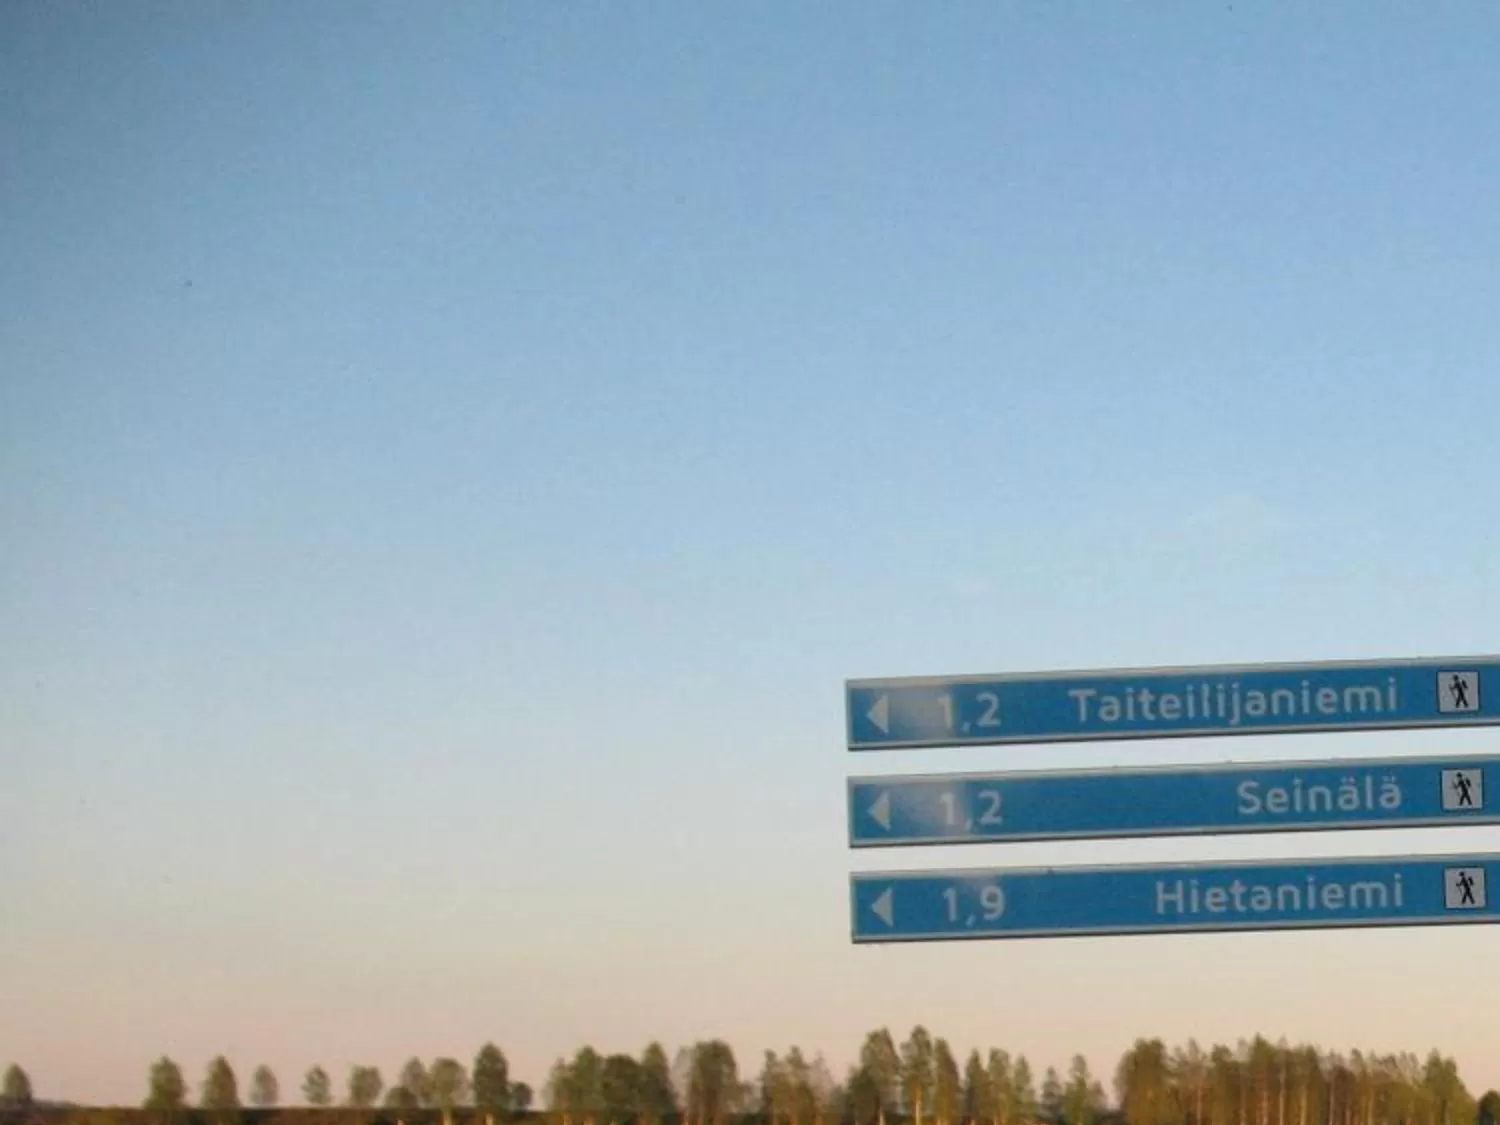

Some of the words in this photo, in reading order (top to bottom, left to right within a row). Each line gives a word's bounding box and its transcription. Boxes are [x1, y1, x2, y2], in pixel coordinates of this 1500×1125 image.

[937, 692, 1001, 733] 1,2
[1068, 676, 1398, 725] Taiteilijaniemi
[940, 790, 1003, 831] 1,2
[1236, 775, 1402, 815] Seinälä
[942, 885, 1005, 928] 1,9
[1155, 873, 1403, 915] Hietaniemi
